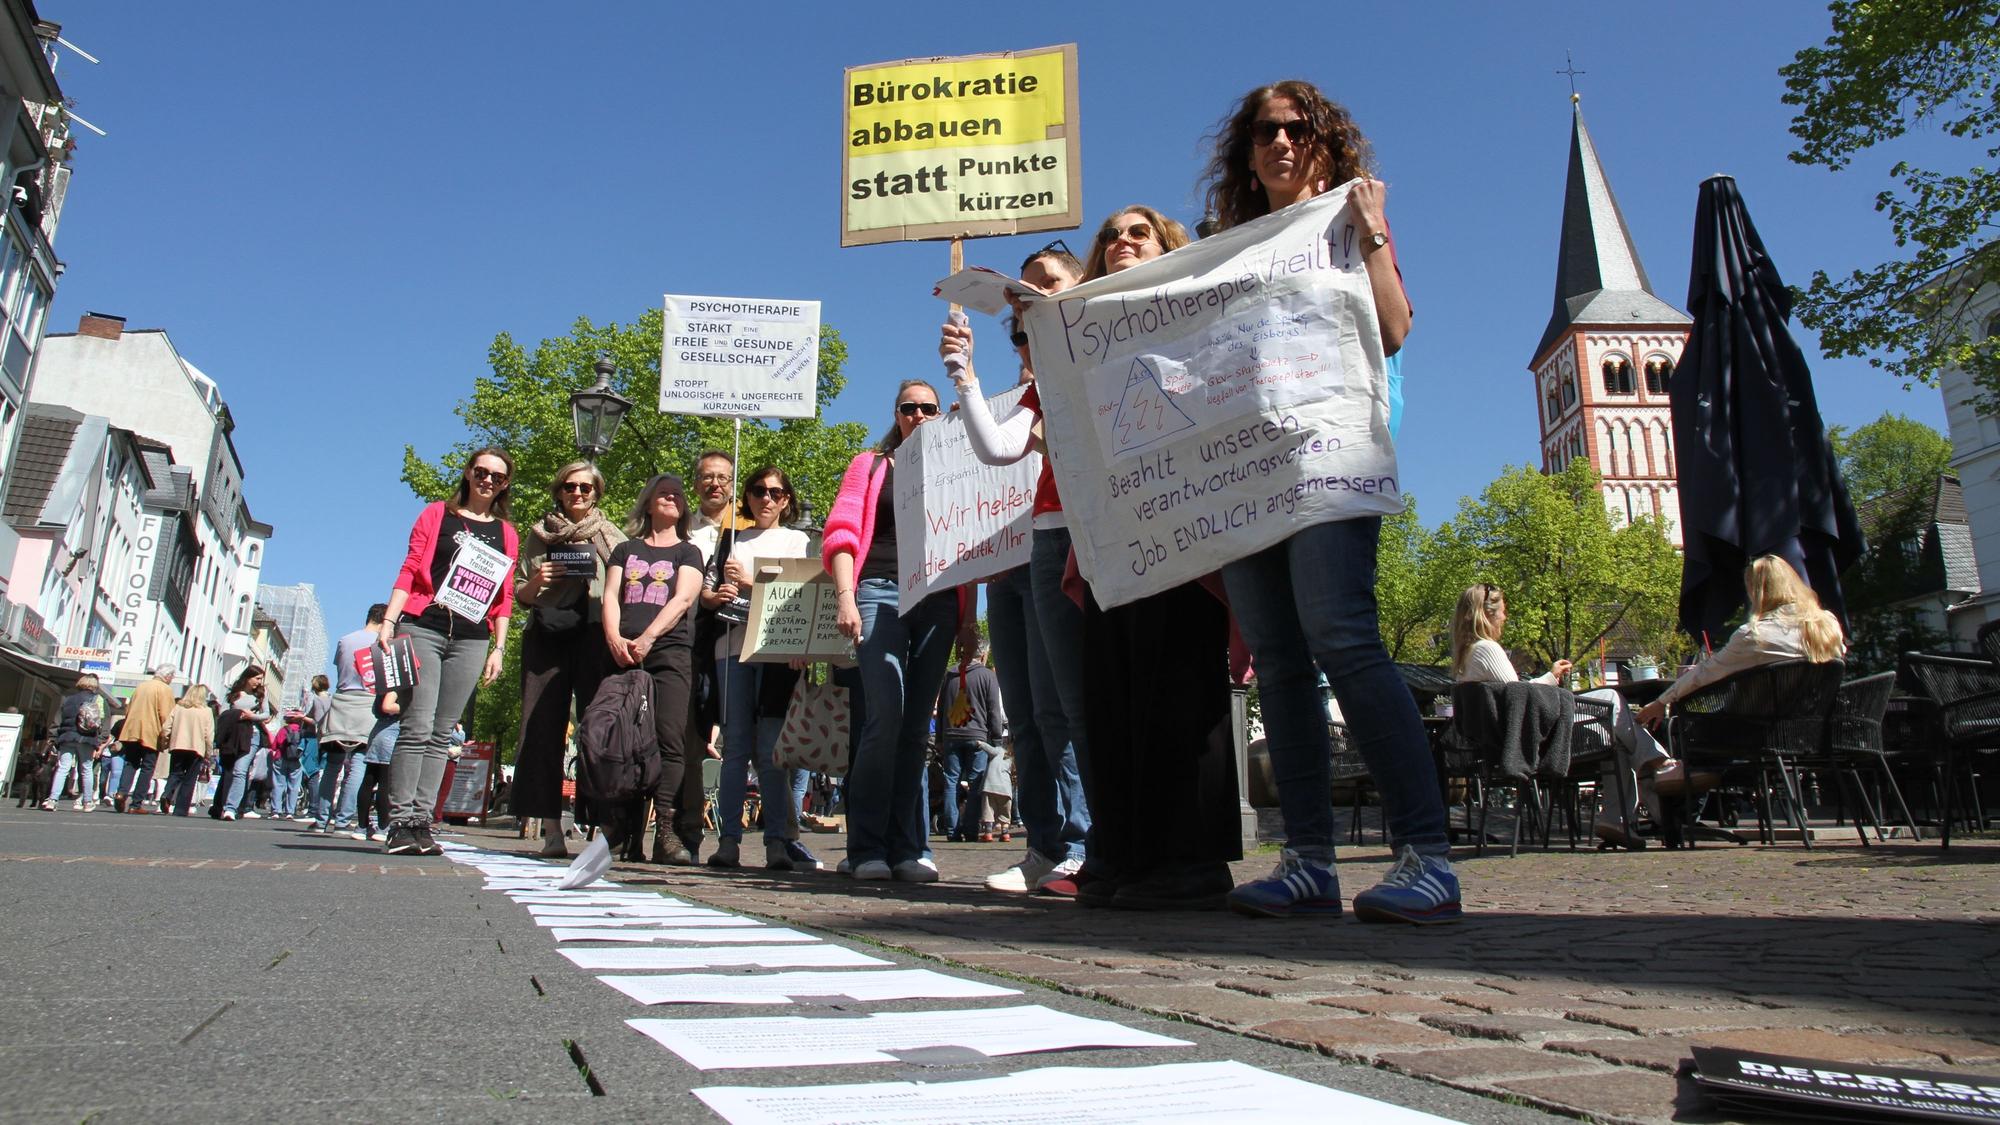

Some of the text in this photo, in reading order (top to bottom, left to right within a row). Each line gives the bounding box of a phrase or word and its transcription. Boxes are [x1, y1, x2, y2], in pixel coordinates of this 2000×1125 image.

[853, 72, 1038, 107] Bürokratie
[852, 117, 1001, 147] abbauen
[959, 153, 1057, 176] Punkte
[851, 164, 948, 200] statt
[959, 190, 1054, 212] kürzen
[1059, 223, 1356, 365] Psychotherapie heilt!
[690, 302, 801, 317] PSYCHOTHERAPIE
[743, 326, 759, 334] EINE
[674, 336, 709, 347] FREIE
[733, 338, 793, 351] GESUNDE
[680, 351, 777, 365] GESELLSCHAFT
[674, 380, 709, 388] STOPPT
[1235, 384, 1248, 395] von
[664, 390, 725, 399] UNLOGISCHE
[741, 392, 804, 400] UNGERECHTE
[1133, 434, 1341, 522] verantwortungsvollen
[926, 485, 1033, 536] Wir helfen
[1127, 475, 1398, 577] Job ENDLICH angemessen
[469, 558, 496, 577] Troisdorf
[476, 553, 495, 569] Praxis
[457, 566, 495, 591] WARTEZEIT
[907, 559, 922, 592] und
[924, 550, 950, 578] die
[116, 517, 157, 666] FOTOGRAF
[452, 575, 490, 603] 1 JAHR
[768, 586, 804, 601] AUCH
[443, 595, 459, 605] NOCH
[447, 590, 481, 609] DEMNÄCHST
[767, 603, 802, 613] UNSER
[782, 627, 803, 635] HAT
[760, 638, 807, 647] GRENZEN
[65, 647, 107, 658] Röseler
